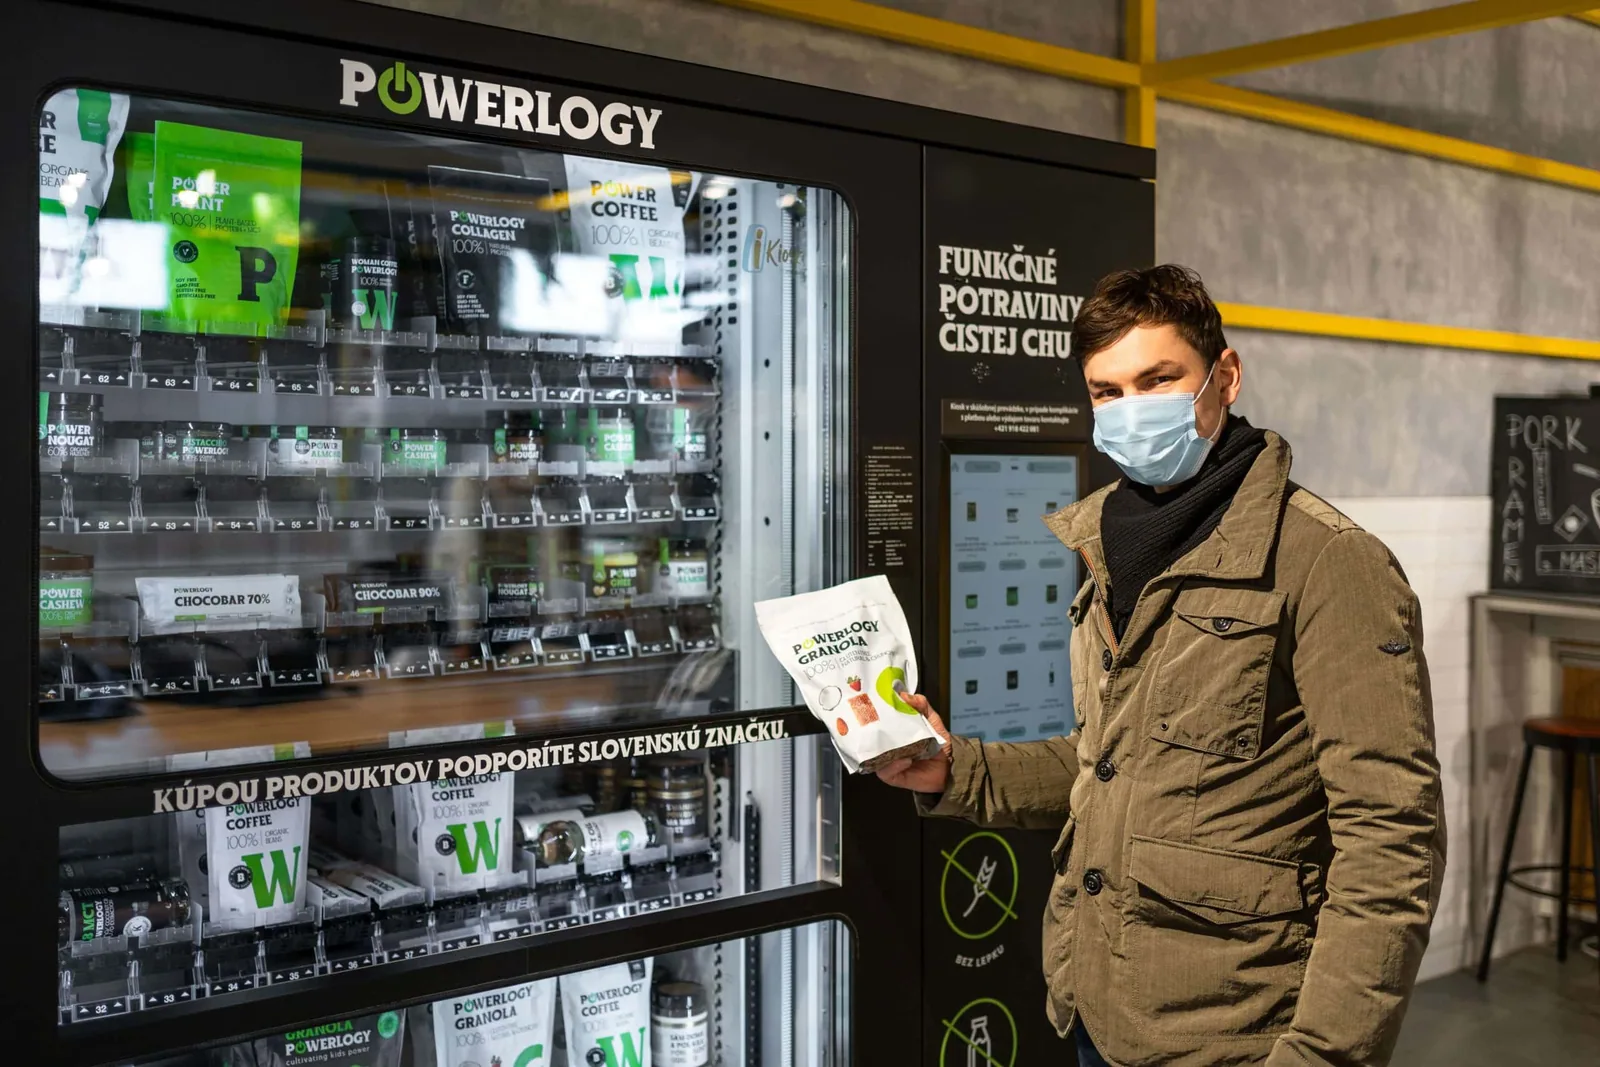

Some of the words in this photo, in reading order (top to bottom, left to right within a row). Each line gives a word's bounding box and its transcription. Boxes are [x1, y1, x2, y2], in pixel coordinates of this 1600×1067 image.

[340, 58, 662, 149] POWERLOGY
[40, 163, 90, 181] ORGA
[172, 177, 230, 196] POER
[590, 179, 657, 203] POWER
[171, 193, 224, 211] PNT
[591, 200, 659, 222] COFFEE
[171, 212, 207, 229] 100%
[450, 210, 526, 230] POWERLOGY
[452, 223, 517, 241] COLLAGEN
[592, 224, 639, 246] 100%
[452, 239, 485, 254] 100%
[351, 258, 379, 266] WOMAN
[939, 244, 1058, 285] FUNKČNÉ
[235, 245, 277, 302] P
[351, 289, 398, 331] W
[938, 283, 1085, 323] POTRAVINY
[938, 313, 1018, 356] ČISTEJ
[1021, 328, 1073, 359] CHU
[98, 375, 110, 383] 62
[165, 379, 176, 387] 63
[230, 382, 240, 390] 64
[350, 386, 360, 394] 66
[406, 386, 416, 394] 67
[48, 424, 91, 435] POWER
[48, 435, 95, 446] NOUGAT
[1505, 412, 1589, 454] PORK
[98, 521, 110, 530] 52
[165, 522, 176, 530] 53
[230, 521, 240, 529] 54
[291, 521, 301, 529] 55
[350, 520, 360, 528] 56
[406, 520, 415, 528] 57
[1501, 455, 1528, 584] RAMEN
[1559, 550, 1600, 575] MAS
[39, 599, 85, 610] CASHEW
[40, 588, 83, 599] POWER
[174, 595, 245, 607] CHOCOBAR
[247, 593, 271, 605] 70%
[355, 588, 417, 601] CHOCOBAR
[418, 586, 441, 598] 90%
[792, 619, 880, 656] POWERLOGY
[797, 635, 868, 665] GRANOLA
[99, 686, 111, 694] 42
[165, 681, 176, 690] 43
[229, 678, 241, 686] 44
[291, 673, 302, 681] 45
[406, 665, 415, 674] 47
[803, 659, 836, 681] 100%
[152, 779, 259, 814] KÚPOU
[265, 760, 434, 801] PRODUKTOV
[436, 740, 575, 780] PODPORÍTE
[578, 724, 701, 762] SLOVENSKÚ
[705, 717, 789, 749] ZNAČKU.
[430, 773, 502, 790] POWERLOGY
[432, 788, 475, 802] COFFEE
[225, 797, 302, 817] POWERLOGY
[432, 804, 462, 820] 100%
[226, 814, 272, 831] COFFEE
[226, 833, 259, 850] 100%
[264, 828, 290, 837] ORGANIC
[264, 836, 283, 844] BEANS
[446, 817, 502, 875] W
[237, 872, 245, 883] B
[241, 845, 302, 909] W
[81, 902, 95, 930] MCT
[94, 900, 104, 938] WERLOGY
[955, 953, 974, 968] BEZ
[975, 945, 1005, 968] LEPKU
[95, 1004, 107, 1014] 32
[163, 994, 175, 1003] 33
[228, 982, 239, 991] 34
[289, 972, 299, 980] 35
[348, 961, 358, 970] 36
[404, 950, 414, 959] 37
[453, 985, 534, 1015] POWERLOGY
[580, 983, 644, 1005] POWERLOGY
[454, 1005, 518, 1031] GRANOLA
[581, 1000, 621, 1017] COFFEE
[285, 1019, 354, 1041] GRANOLA
[285, 1029, 372, 1057] POWERLOGY
[285, 1052, 329, 1067] cultivating
[330, 1049, 346, 1060] kids
[347, 1045, 371, 1057] power
